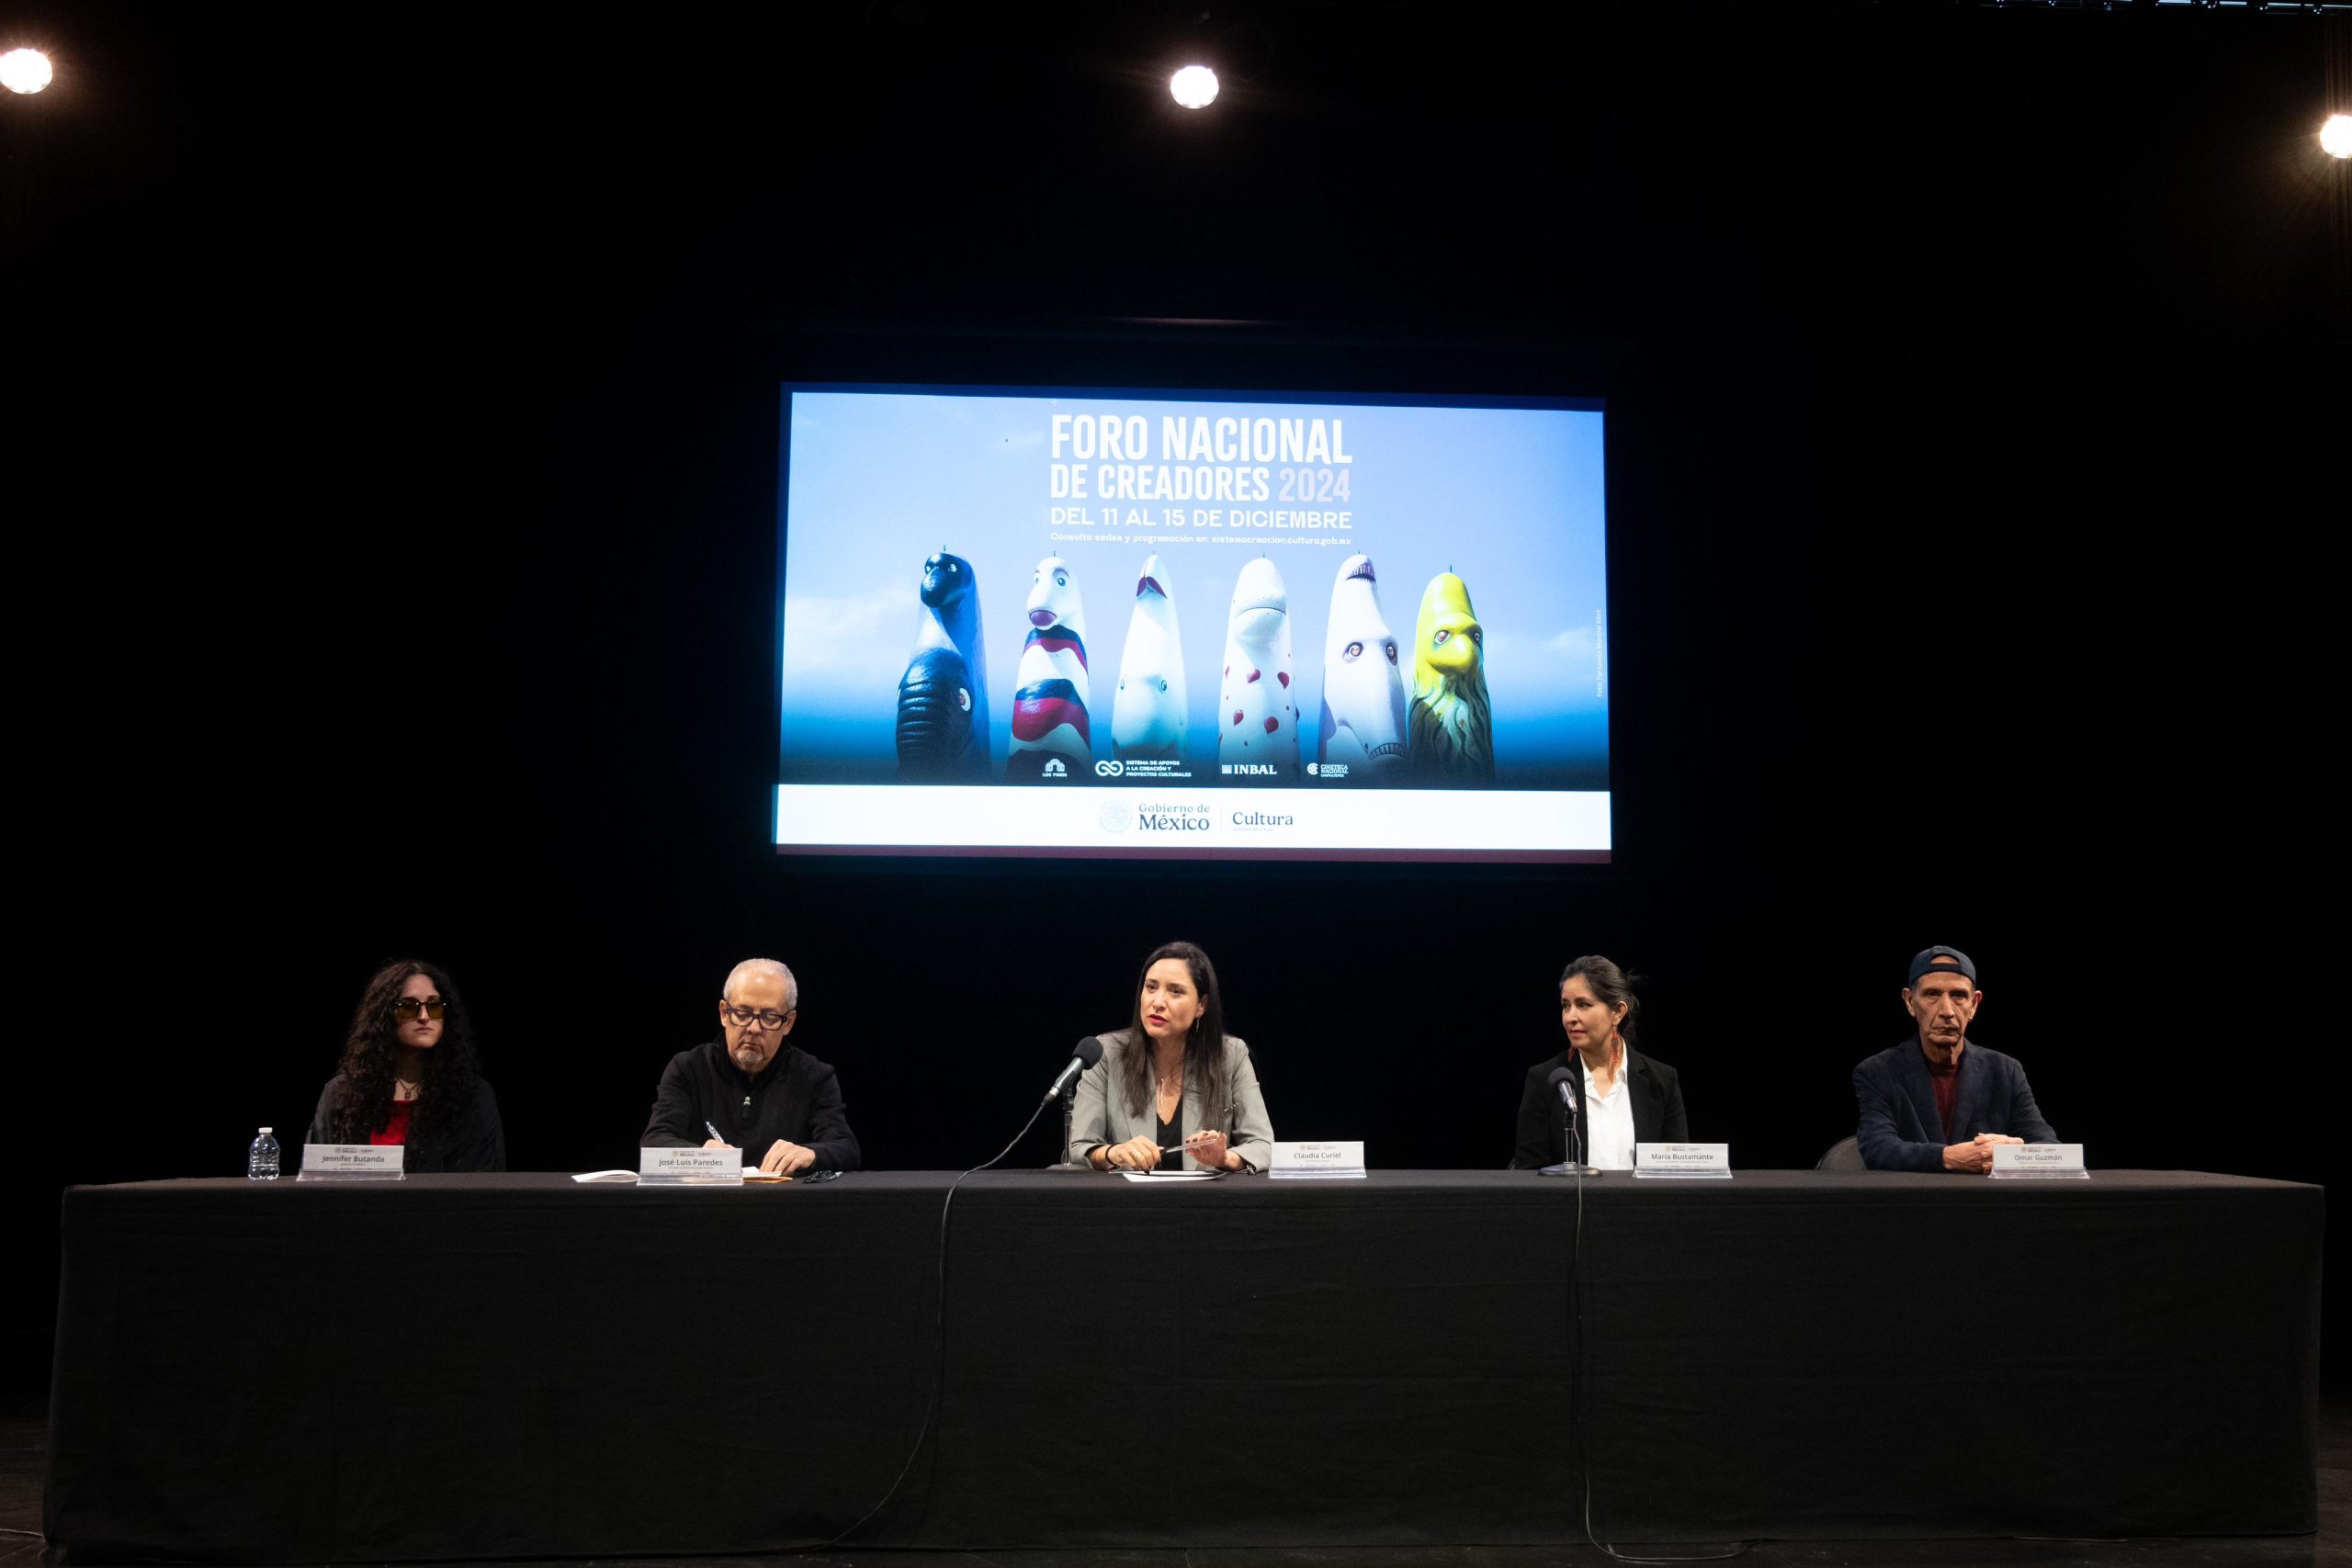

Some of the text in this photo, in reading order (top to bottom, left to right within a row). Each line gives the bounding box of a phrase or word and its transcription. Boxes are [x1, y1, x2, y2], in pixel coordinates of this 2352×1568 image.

[1051, 414, 1352, 464] FORO NACIONAL
[1050, 464, 1351, 502] DE CREADORES 2024
[1050, 506, 1352, 530] DEL 11 AL 15 DE DICIEMBRE
[1050, 532, 1092, 541] Consulta
[1094, 533, 1123, 542] sedes
[1124, 536, 1132, 544] y
[1133, 534, 1194, 545] programación
[1233, 764, 1278, 775] INBAL
[1138, 803, 1210, 814] Gobierno de
[1138, 813, 1210, 831] México
[1232, 811, 1294, 826] Cultura
[322, 1155, 385, 1164] Jennifer Butanda
[658, 1158, 723, 1168] José Luis Paredes
